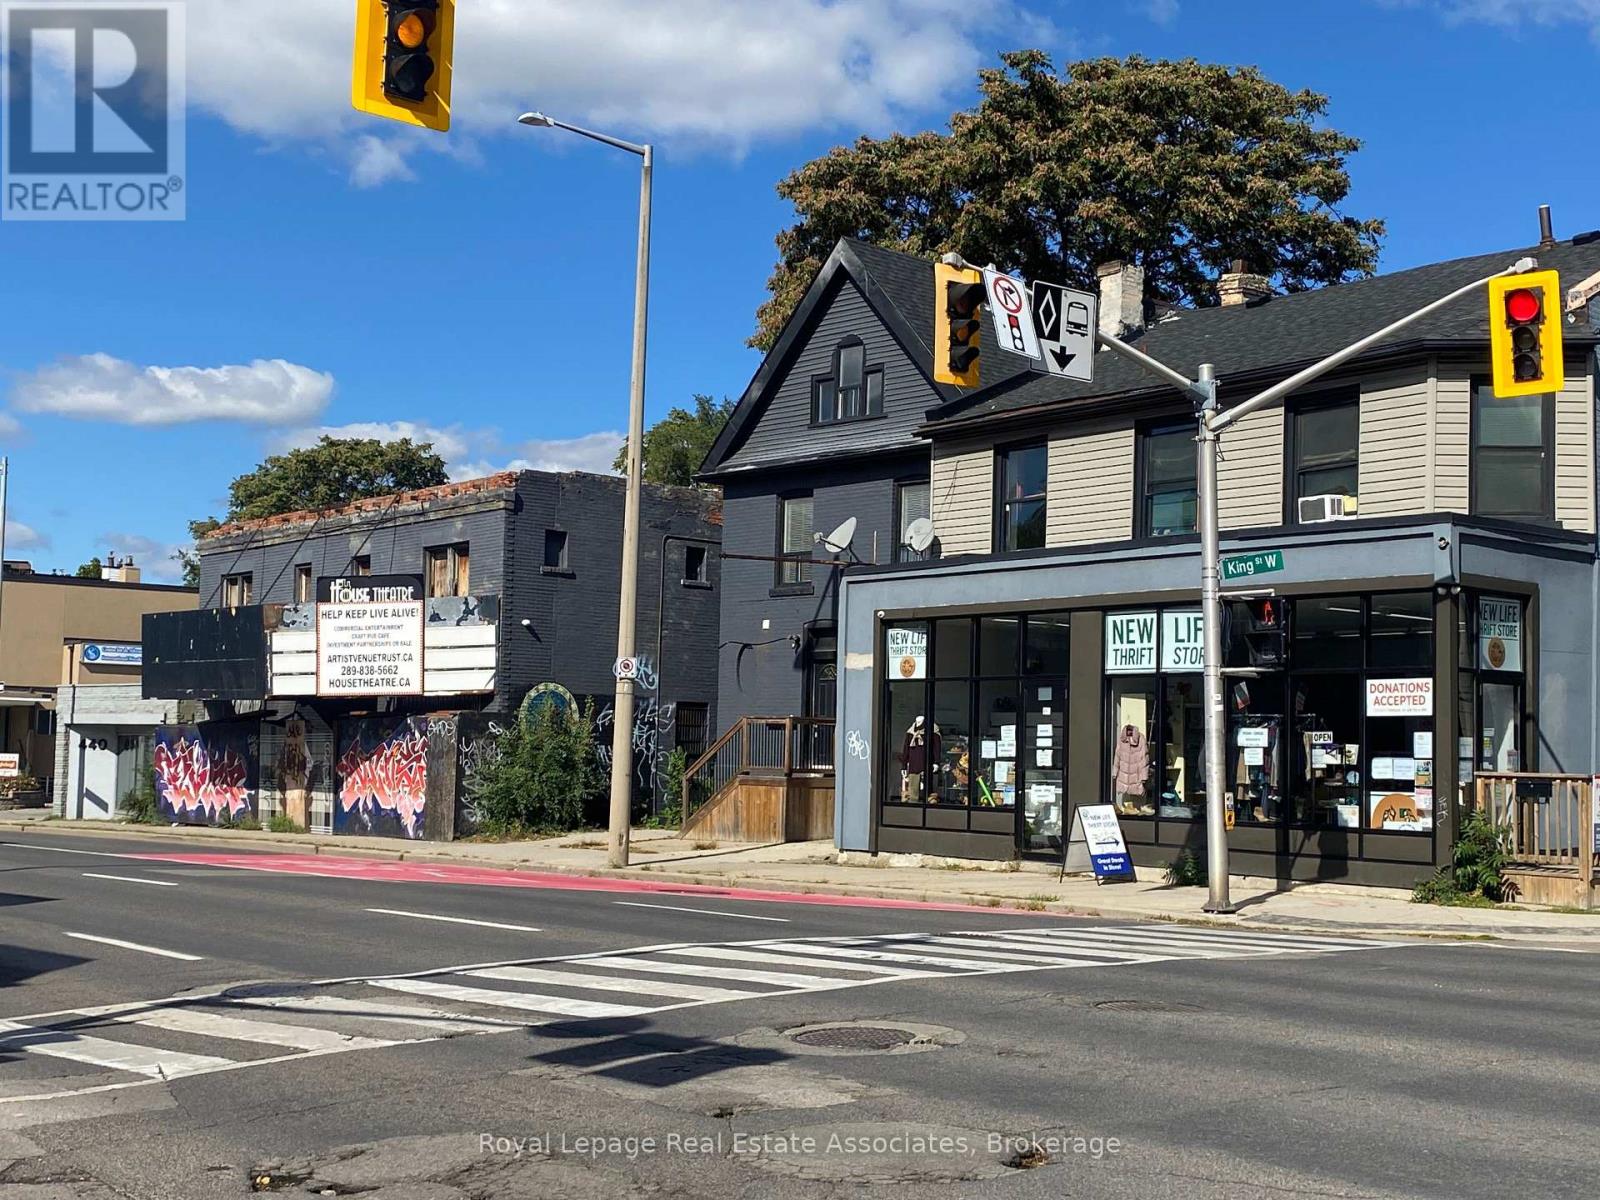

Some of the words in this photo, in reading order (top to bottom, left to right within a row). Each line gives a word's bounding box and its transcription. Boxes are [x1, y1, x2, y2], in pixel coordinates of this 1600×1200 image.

[1227, 560, 1254, 575] King
[1255, 557, 1263, 565] St
[1264, 554, 1277, 568] W
[372, 586, 414, 602] THEATRE
[321, 610, 343, 619] HELP
[345, 609, 368, 619] KEEP
[369, 609, 389, 618] LIVE
[391, 608, 419, 618] ALIVE!
[1499, 604, 1518, 623] LIFE
[1112, 617, 1154, 645] NEW
[1174, 616, 1204, 643] LIF
[1497, 623, 1518, 638] STORE
[890, 632, 910, 646] NEW
[911, 632, 927, 645] LIF
[890, 646, 908, 656] THRIFT
[909, 645, 927, 655] STOR
[1112, 646, 1154, 666] THRIFT
[1173, 646, 1205, 665] STOR
[327, 653, 413, 663] ARTISTVENUETRUST.CA
[341, 665, 399, 676] 289-838-5662
[329, 677, 411, 688] HOUSETHEATRE.CA
[1370, 682, 1431, 694] DONATIONS
[1373, 695, 1426, 706] ACCEPTED
[1313, 733, 1332, 742] OPEN
[79, 738, 108, 751] 440
